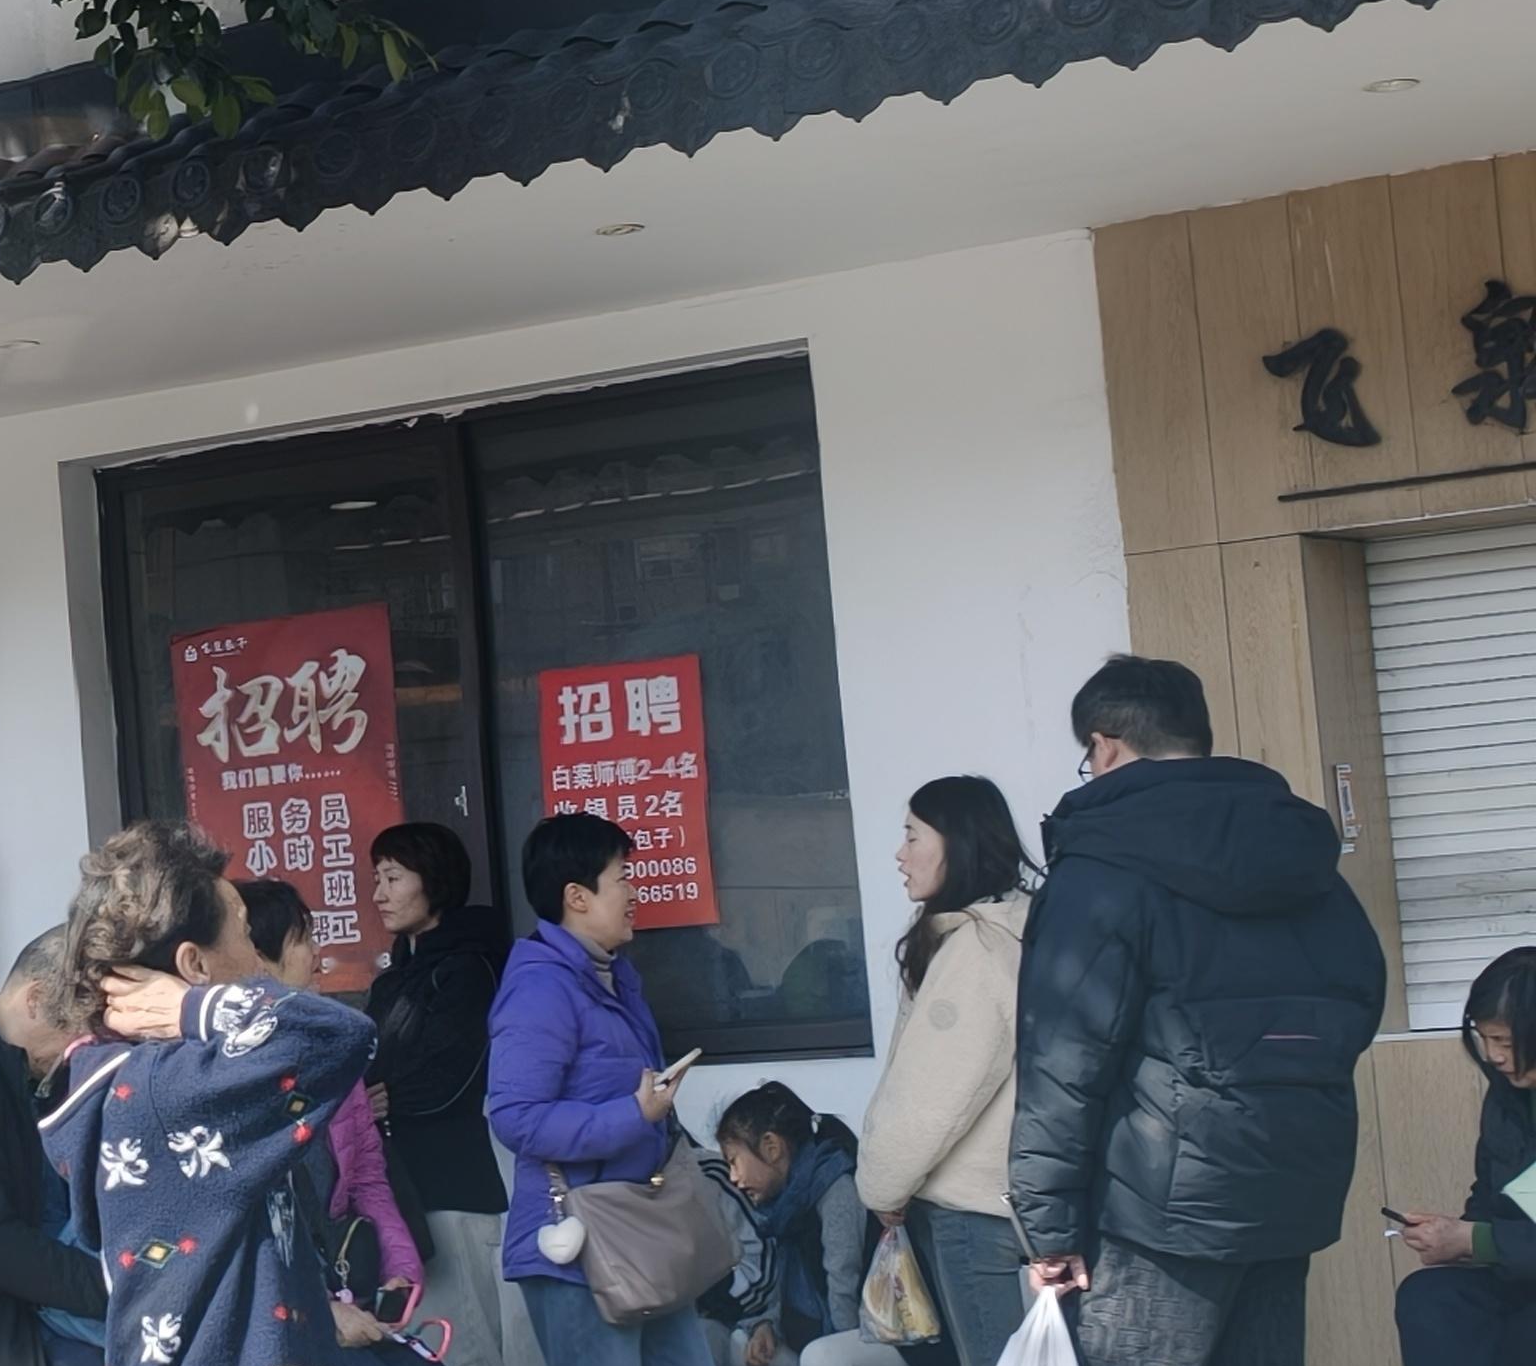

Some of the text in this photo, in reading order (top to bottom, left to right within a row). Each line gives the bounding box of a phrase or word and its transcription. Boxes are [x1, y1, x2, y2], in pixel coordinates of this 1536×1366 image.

[196, 647, 369, 764] 招聘
[558, 675, 683, 745] 招聘
[243, 793, 351, 840] 服务员
[626, 825, 686, 851] 包子）
[246, 834, 354, 877] 小时工
